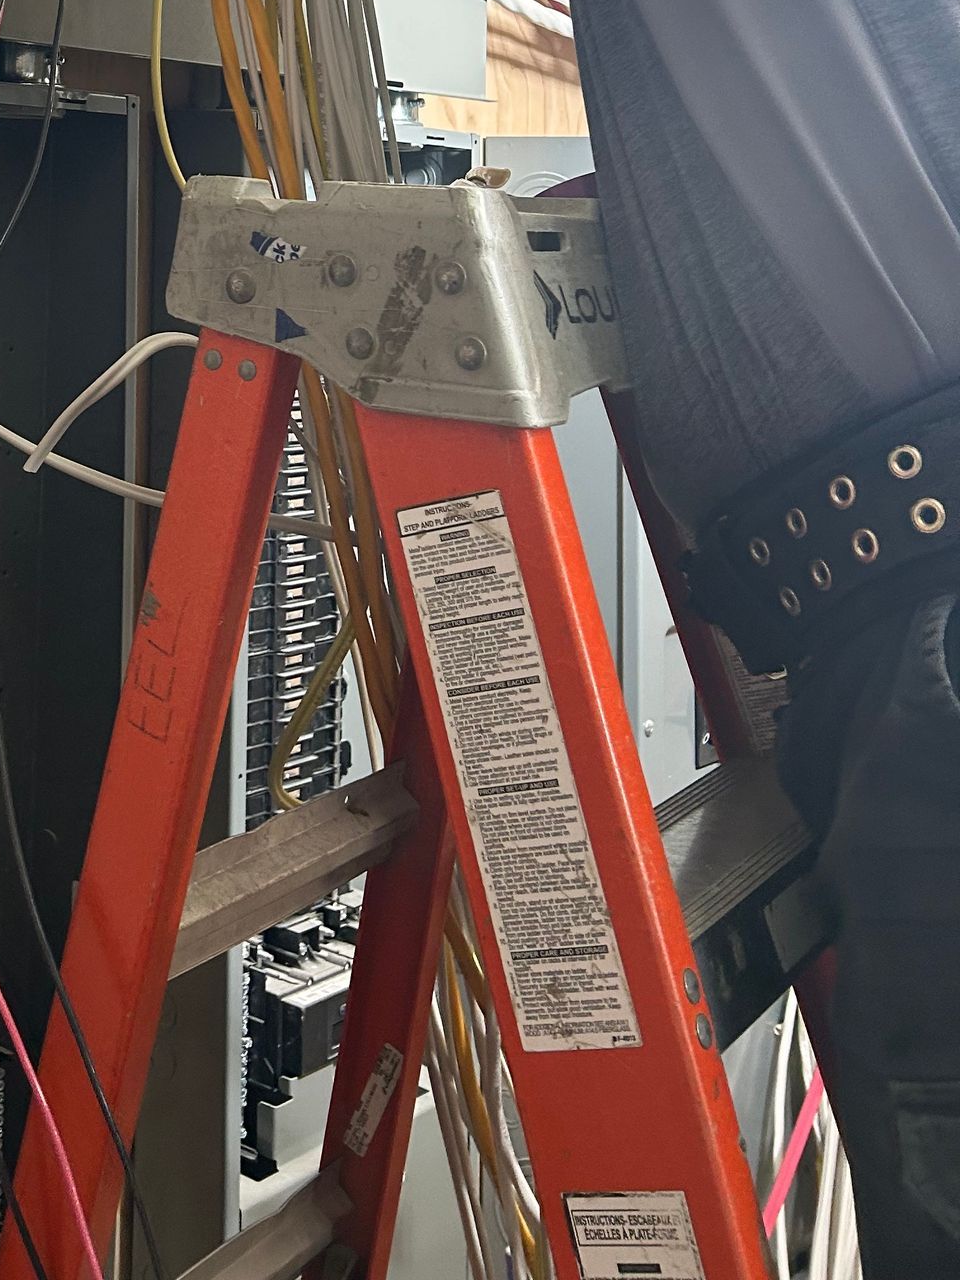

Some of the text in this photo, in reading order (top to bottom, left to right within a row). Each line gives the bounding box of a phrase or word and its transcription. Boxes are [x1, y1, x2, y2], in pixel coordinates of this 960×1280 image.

[403, 523, 420, 532] STEP
[421, 520, 434, 529] AND
[470, 507, 500, 519] LADDERS
[435, 567, 496, 583] PROPER SELECTION
[430, 619, 466, 630] INSPECTION
[466, 614, 492, 624] BEFORE
[493, 611, 510, 620] EACH
[510, 609, 524, 617] USE
[448, 686, 481, 696] CONSIDER
[481, 682, 508, 691] BEFORE
[508, 679, 526, 687] EACH
[479, 787, 506, 795] PROPER
[529, 782, 544, 790] AND
[512, 951, 540, 959] PROPER
[575, 947, 608, 955] STORAGE
[574, 1215, 627, 1226] INSTRUCTIONS-
[584, 1226, 621, 1241] ÉCHELLES
